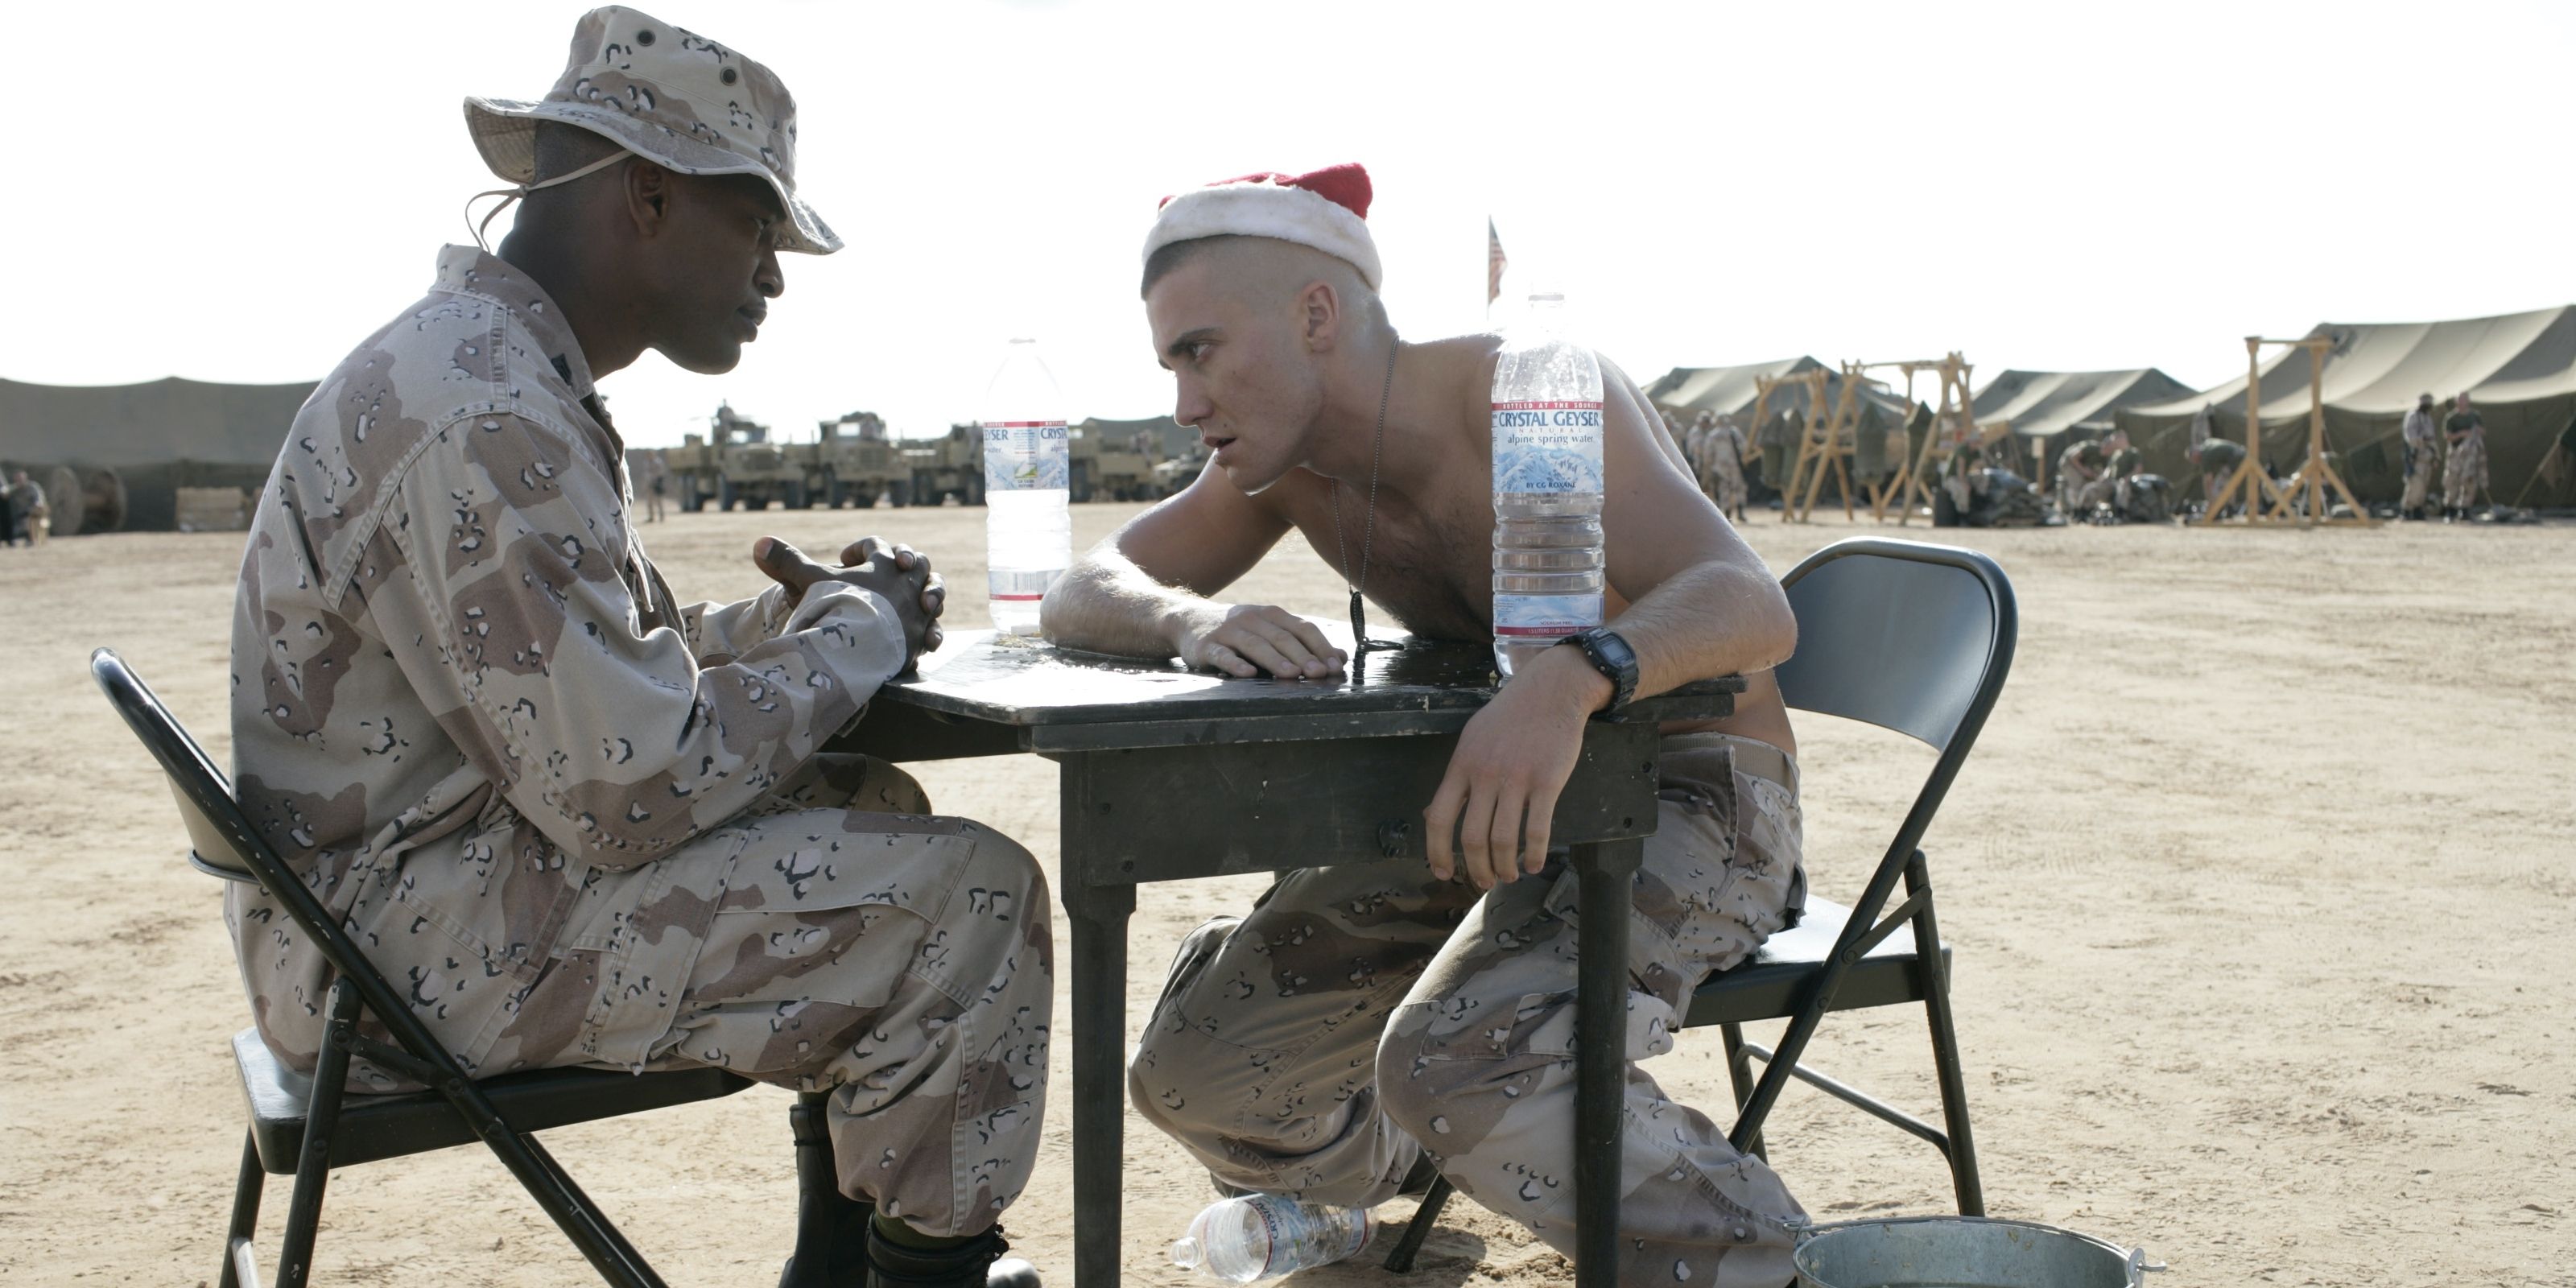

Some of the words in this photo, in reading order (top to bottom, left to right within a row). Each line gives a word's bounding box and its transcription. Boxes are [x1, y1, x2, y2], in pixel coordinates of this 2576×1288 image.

[1554, 402, 1569, 410] THE
[1499, 411, 1549, 427] CRYSTAL
[1553, 411, 1600, 427] GEYSER
[1508, 433, 1534, 446] alpine
[1538, 433, 1569, 445] spring
[1571, 434, 1594, 443] water
